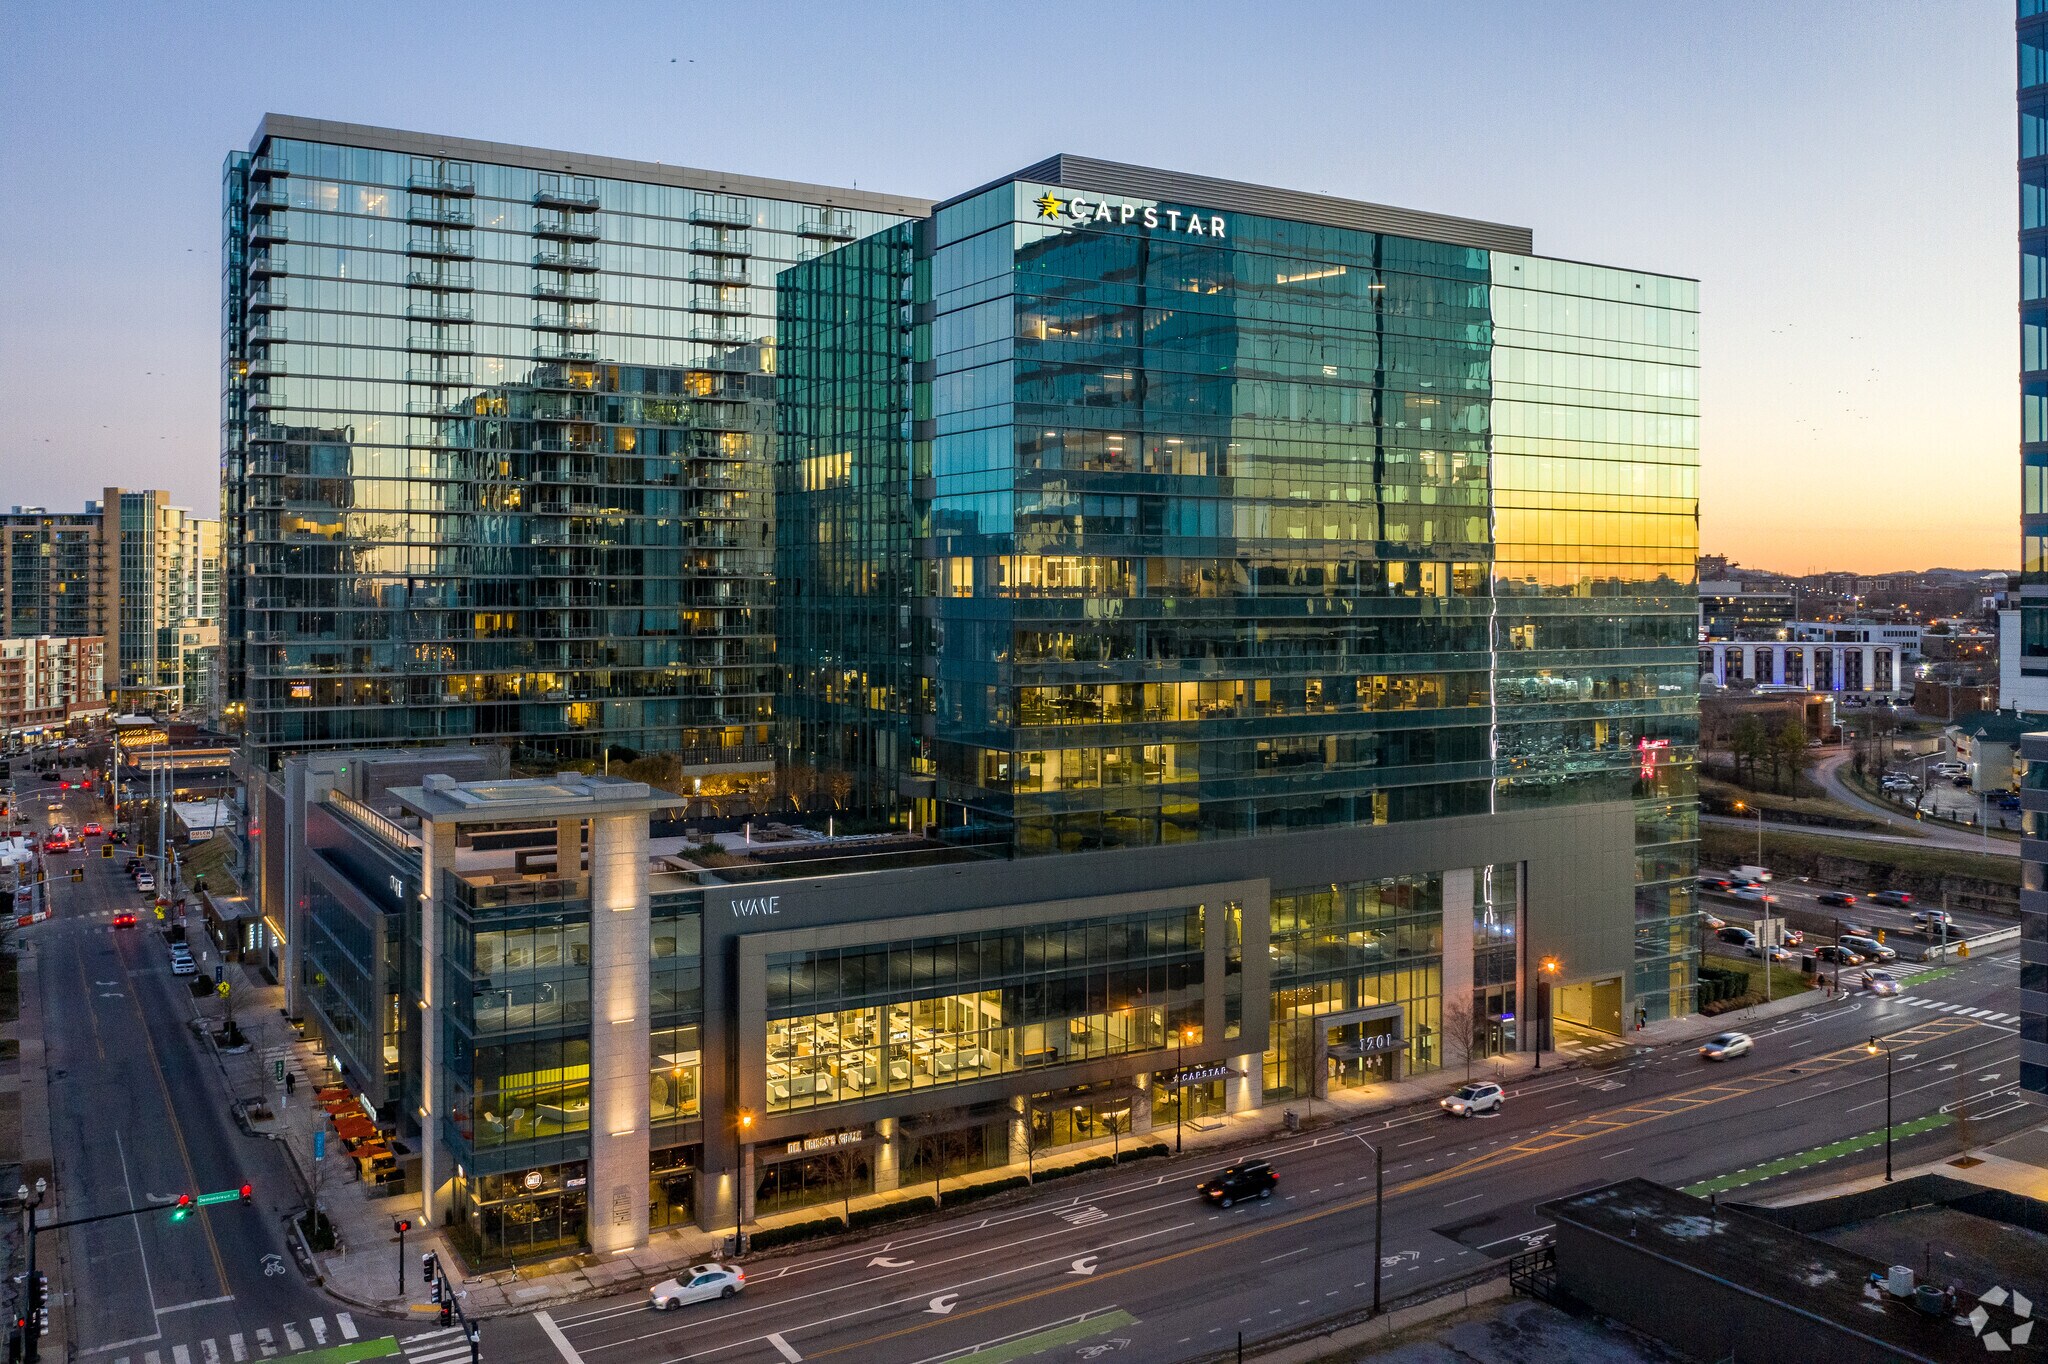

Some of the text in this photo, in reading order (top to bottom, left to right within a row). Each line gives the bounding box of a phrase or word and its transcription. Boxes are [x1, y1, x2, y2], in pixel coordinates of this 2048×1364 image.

[1070, 197, 1226, 238] CAPSTAR
[1360, 1033, 1392, 1051] 1201
[1181, 1066, 1227, 1082] CAPSTAR
[1052, 1204, 1109, 1225] ONLY
